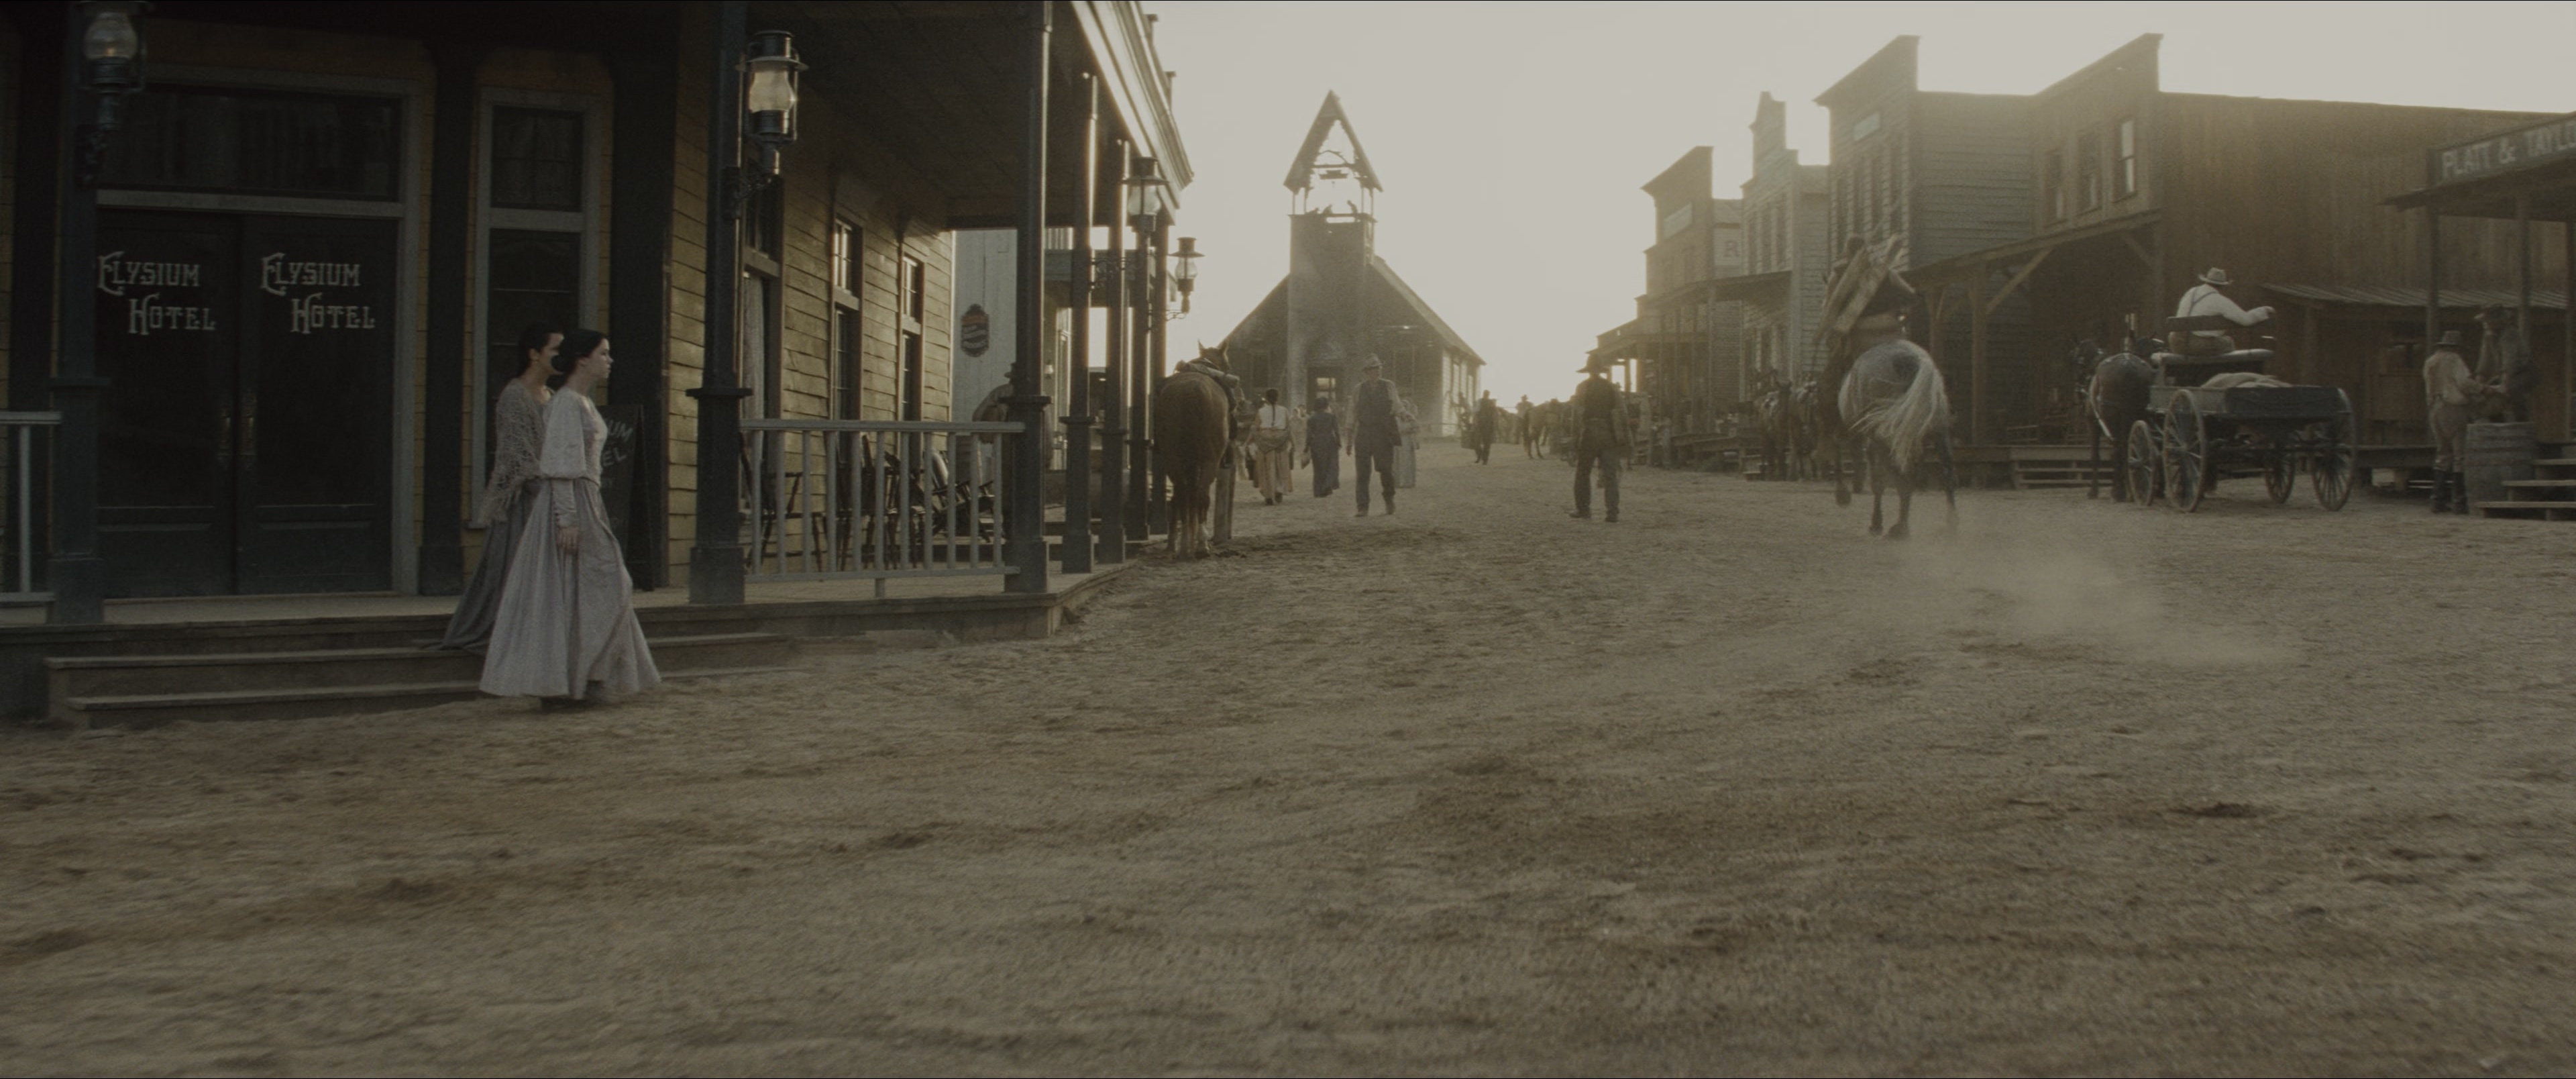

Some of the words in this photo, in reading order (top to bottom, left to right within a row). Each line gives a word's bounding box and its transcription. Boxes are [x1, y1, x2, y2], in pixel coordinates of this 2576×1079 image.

[2443, 142, 2491, 177] PLATT
[2499, 136, 2516, 164] &
[97, 251, 201, 297] ELYSIUM
[260, 252, 361, 297] ELYSIUM
[129, 292, 217, 336] HOTEL
[290, 292, 376, 334] HOTEL
